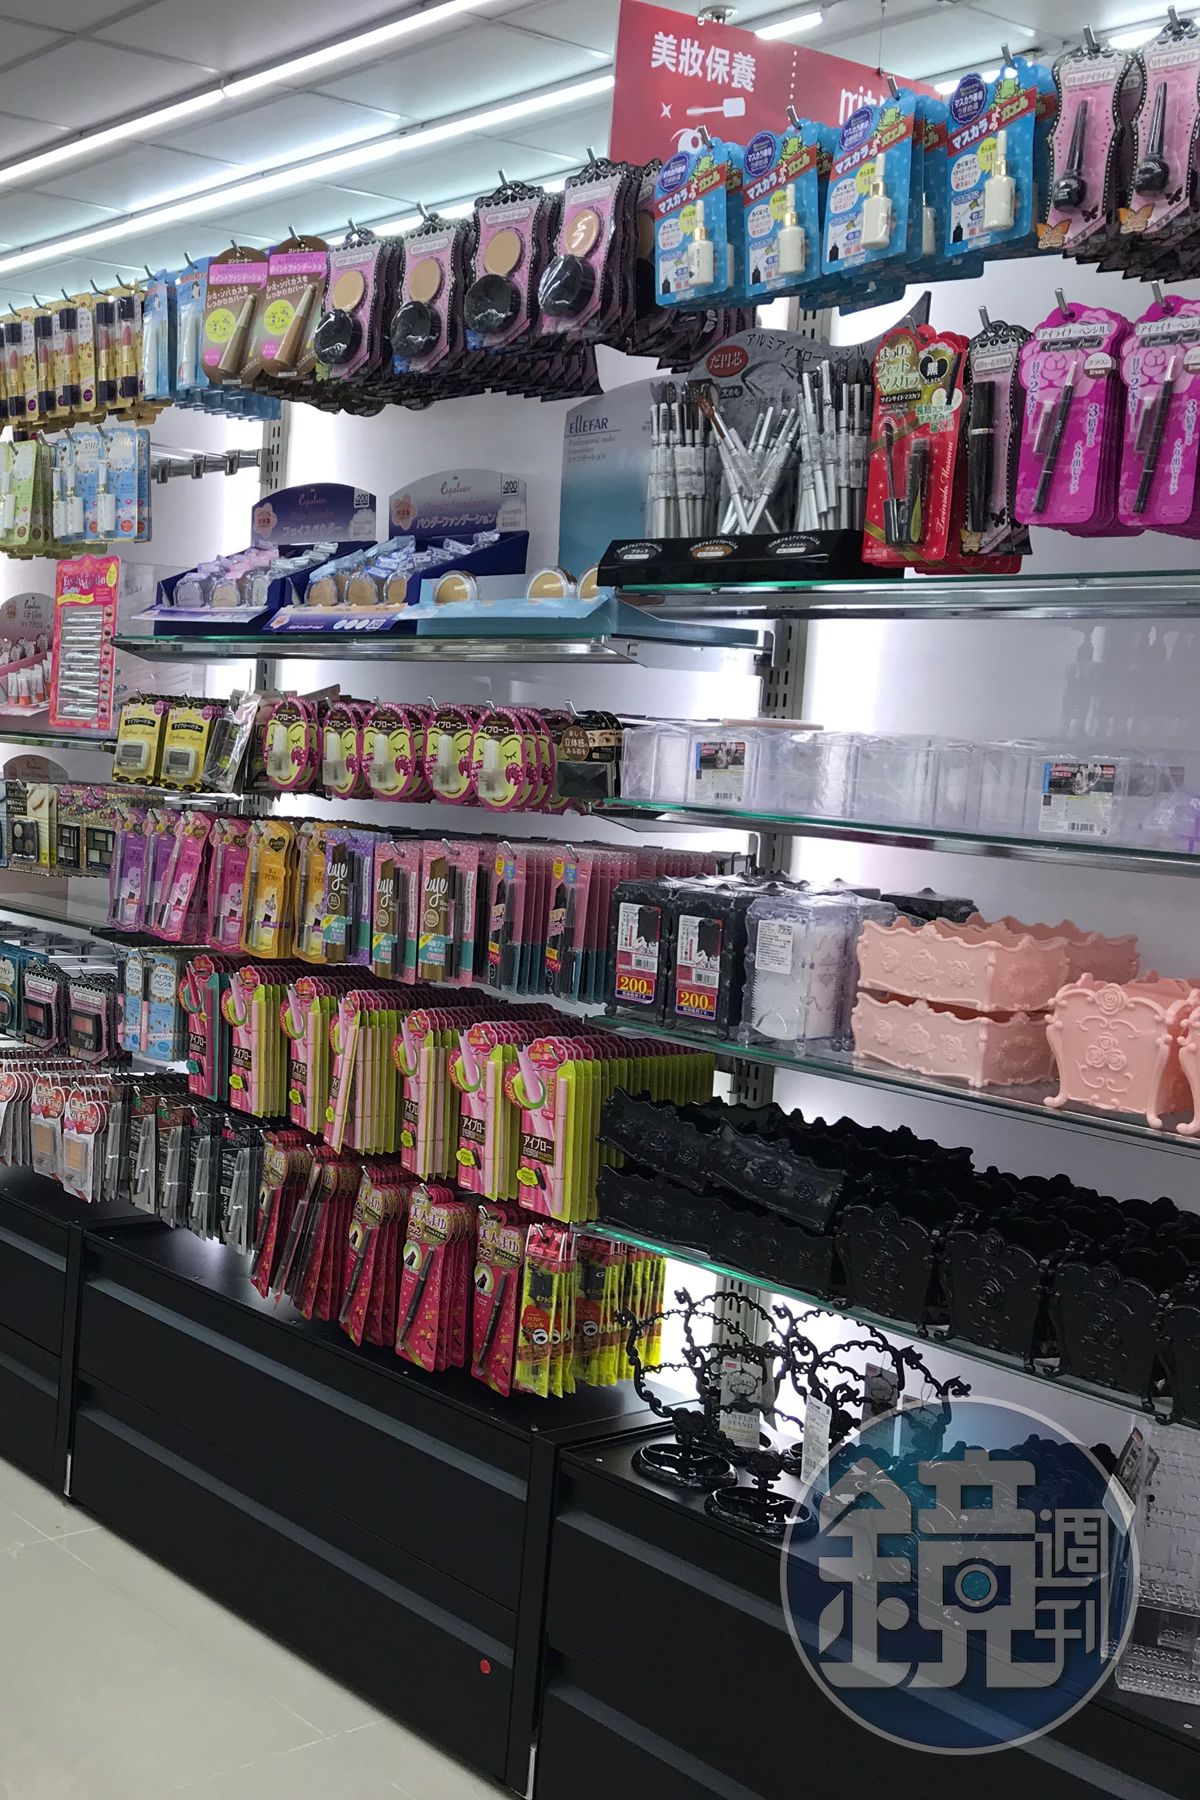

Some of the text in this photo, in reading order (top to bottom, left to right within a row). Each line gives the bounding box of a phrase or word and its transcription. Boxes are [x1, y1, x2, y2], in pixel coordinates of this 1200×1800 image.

[650, 31, 756, 92] 美妝保養
[1039, 326, 1107, 338] アイライナーペンシル
[746, 332, 868, 364] アルミアイブローンシル
[709, 351, 743, 370] だ円芯
[927, 361, 939, 376] 黒
[415, 512, 497, 530] パウダーファンデーション
[424, 877, 448, 908] eye
[523, 1136, 553, 1152] アイブロー
[411, 1205, 447, 1230] 美人まゆ
[479, 1228, 520, 1253] 美人まゆ
[722, 1412, 760, 1424] JEWELRY
[727, 1420, 753, 1430] STAND
